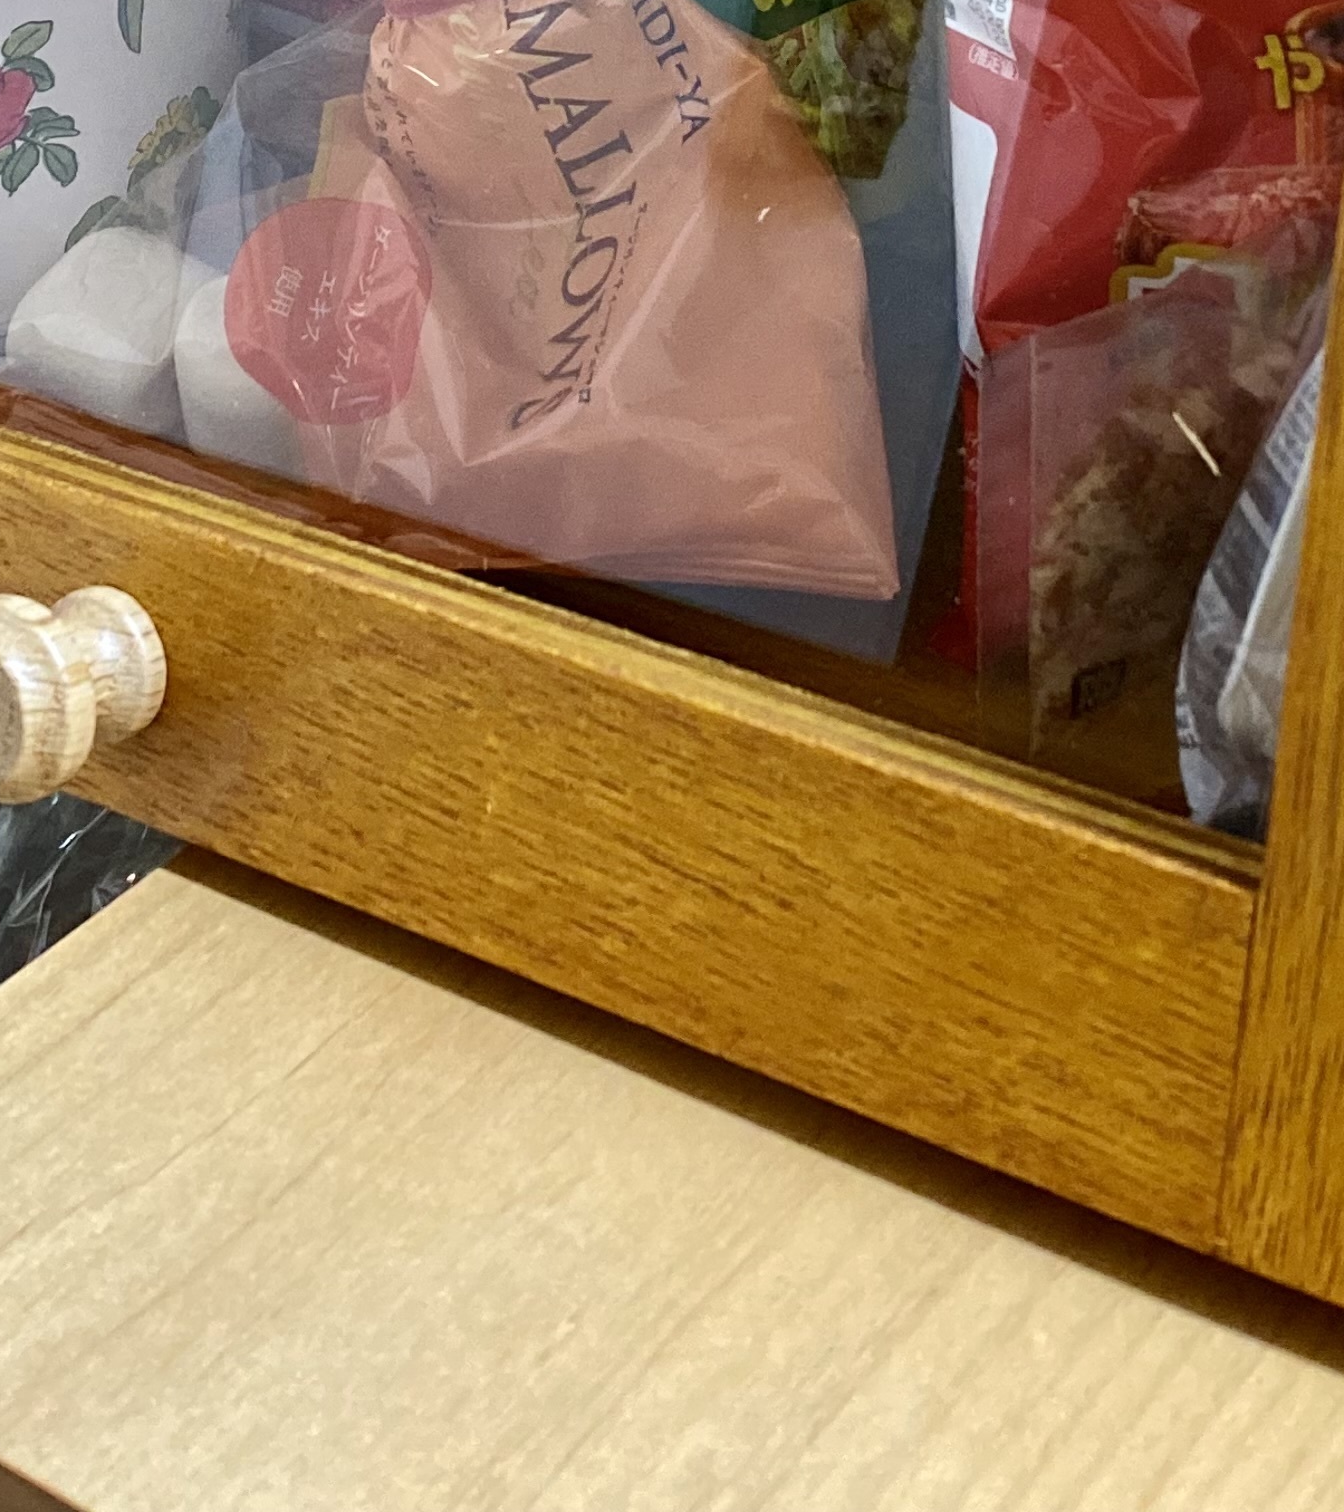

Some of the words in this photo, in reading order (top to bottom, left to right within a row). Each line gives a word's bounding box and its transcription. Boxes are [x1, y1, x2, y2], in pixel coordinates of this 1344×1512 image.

[265, 263, 304, 319] 使用
[300, 269, 337, 342] エキス
